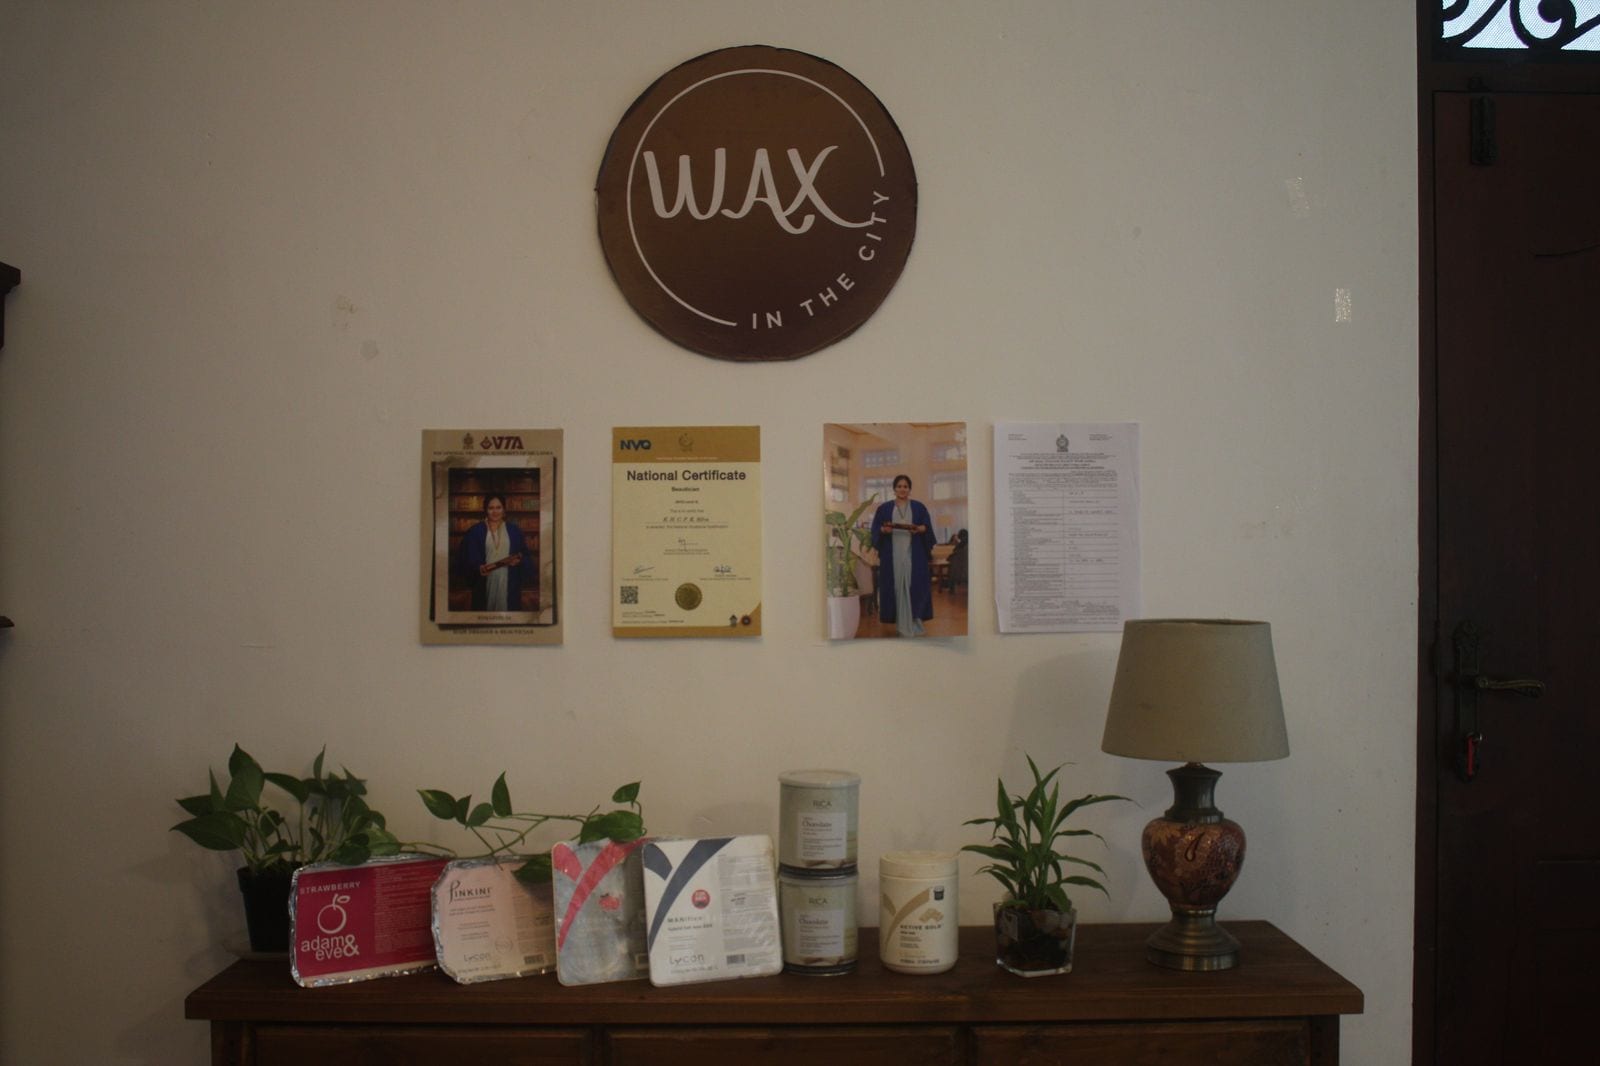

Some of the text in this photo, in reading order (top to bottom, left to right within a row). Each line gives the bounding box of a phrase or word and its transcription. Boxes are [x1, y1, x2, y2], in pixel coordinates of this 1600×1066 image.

[643, 145, 866, 234] WAX
[752, 190, 890, 329] IN THE CITY
[492, 436, 524, 449] VTA
[620, 439, 651, 450] NVQ
[627, 470, 746, 481] National Certificate
[300, 881, 361, 895] STRAWBERRY
[301, 935, 345, 952] adam
[315, 946, 343, 961] eve
